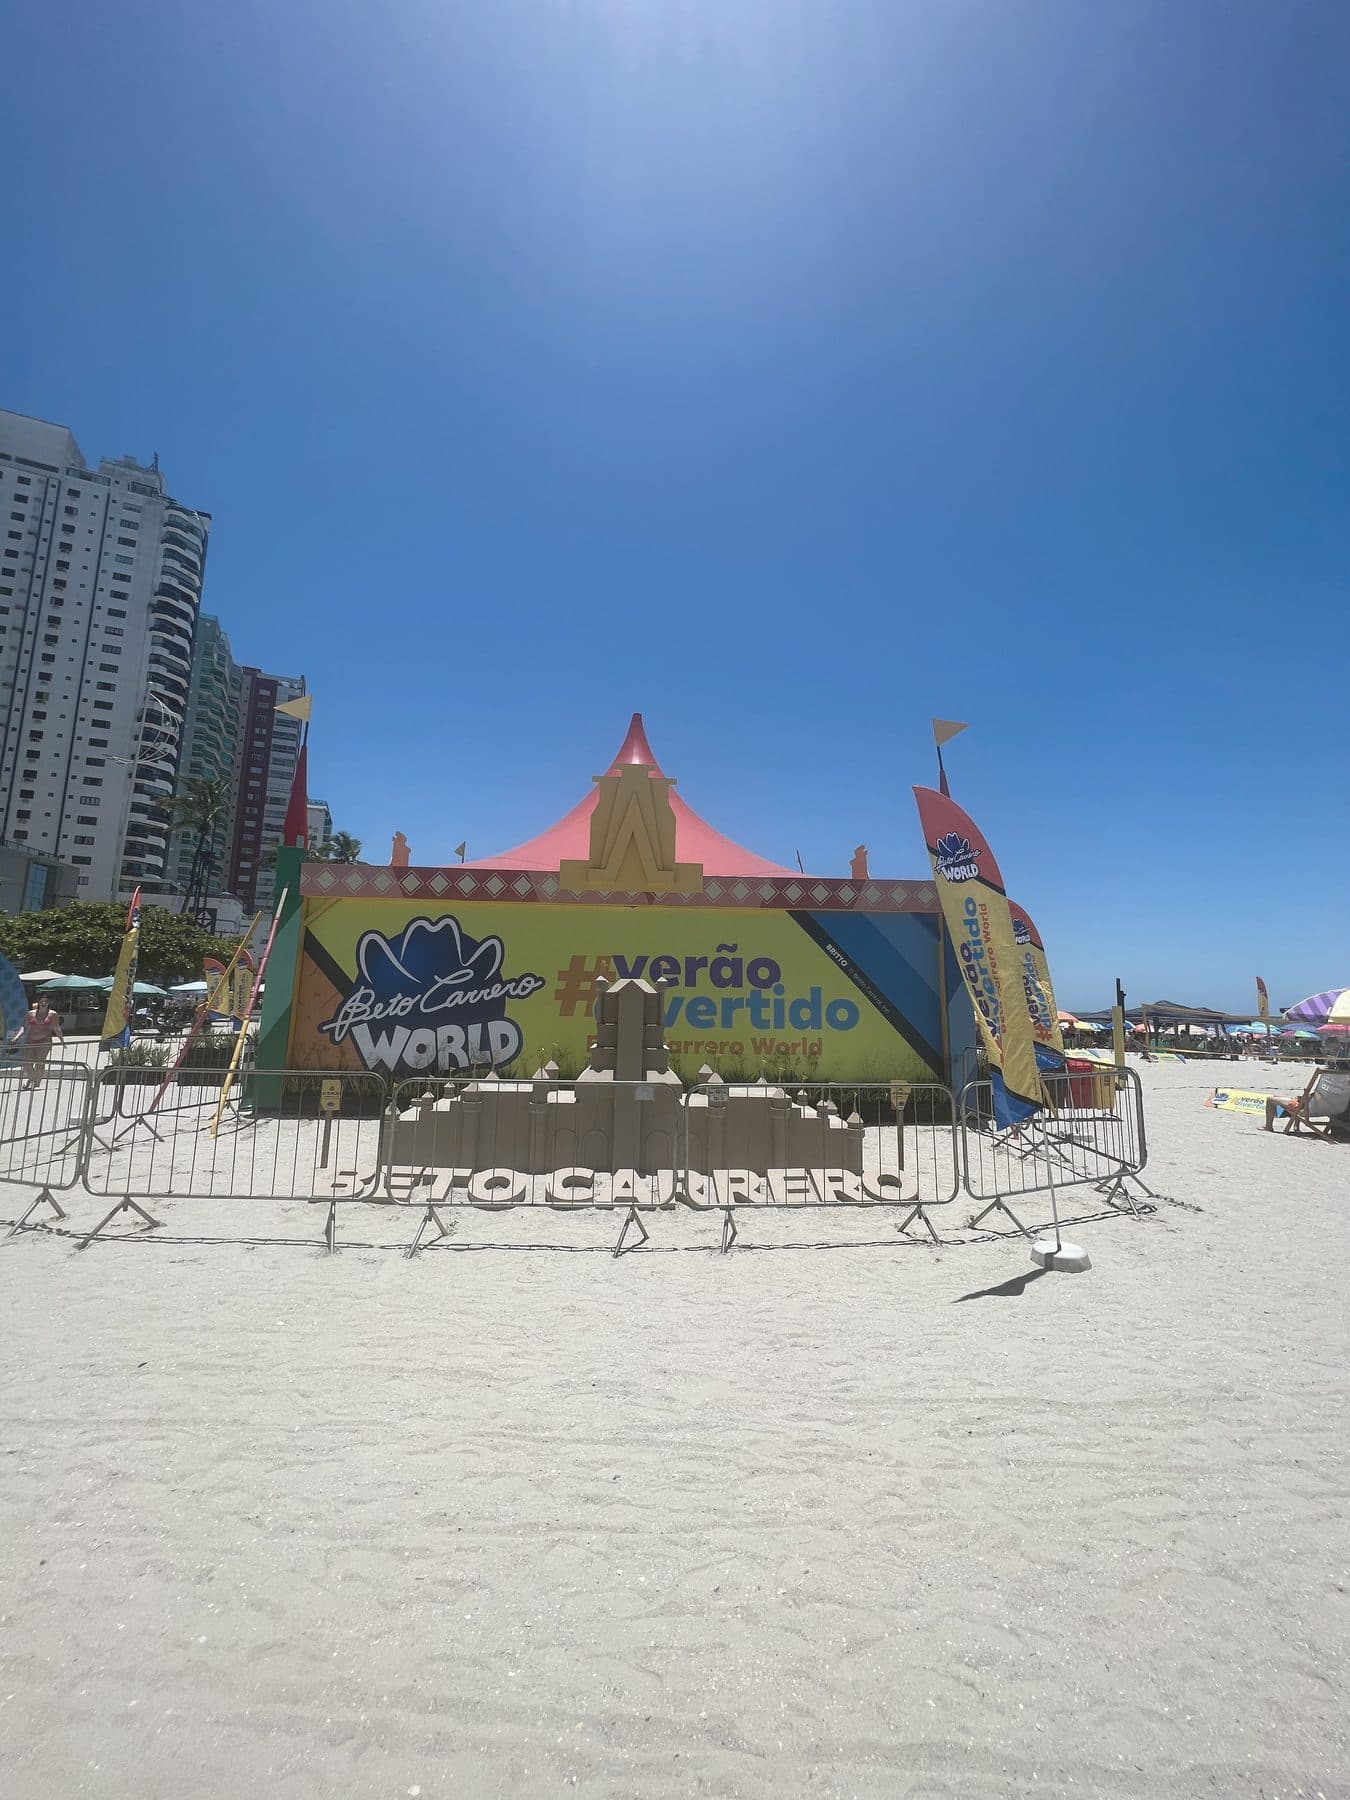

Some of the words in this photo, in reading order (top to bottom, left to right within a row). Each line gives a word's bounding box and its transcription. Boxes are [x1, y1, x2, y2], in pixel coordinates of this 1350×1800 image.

[942, 864, 979, 880] WORLD
[978, 903, 991, 943] World
[825, 944, 848, 967] BRITTO
[323, 987, 421, 1042] Beto
[420, 969, 543, 1013] Carrero
[594, 983, 860, 1031] vertido
[351, 1020, 519, 1072] WORLD
[660, 1036, 744, 1056] arrero
[751, 1037, 823, 1056] World
[311, 1165, 527, 1203] BETO
